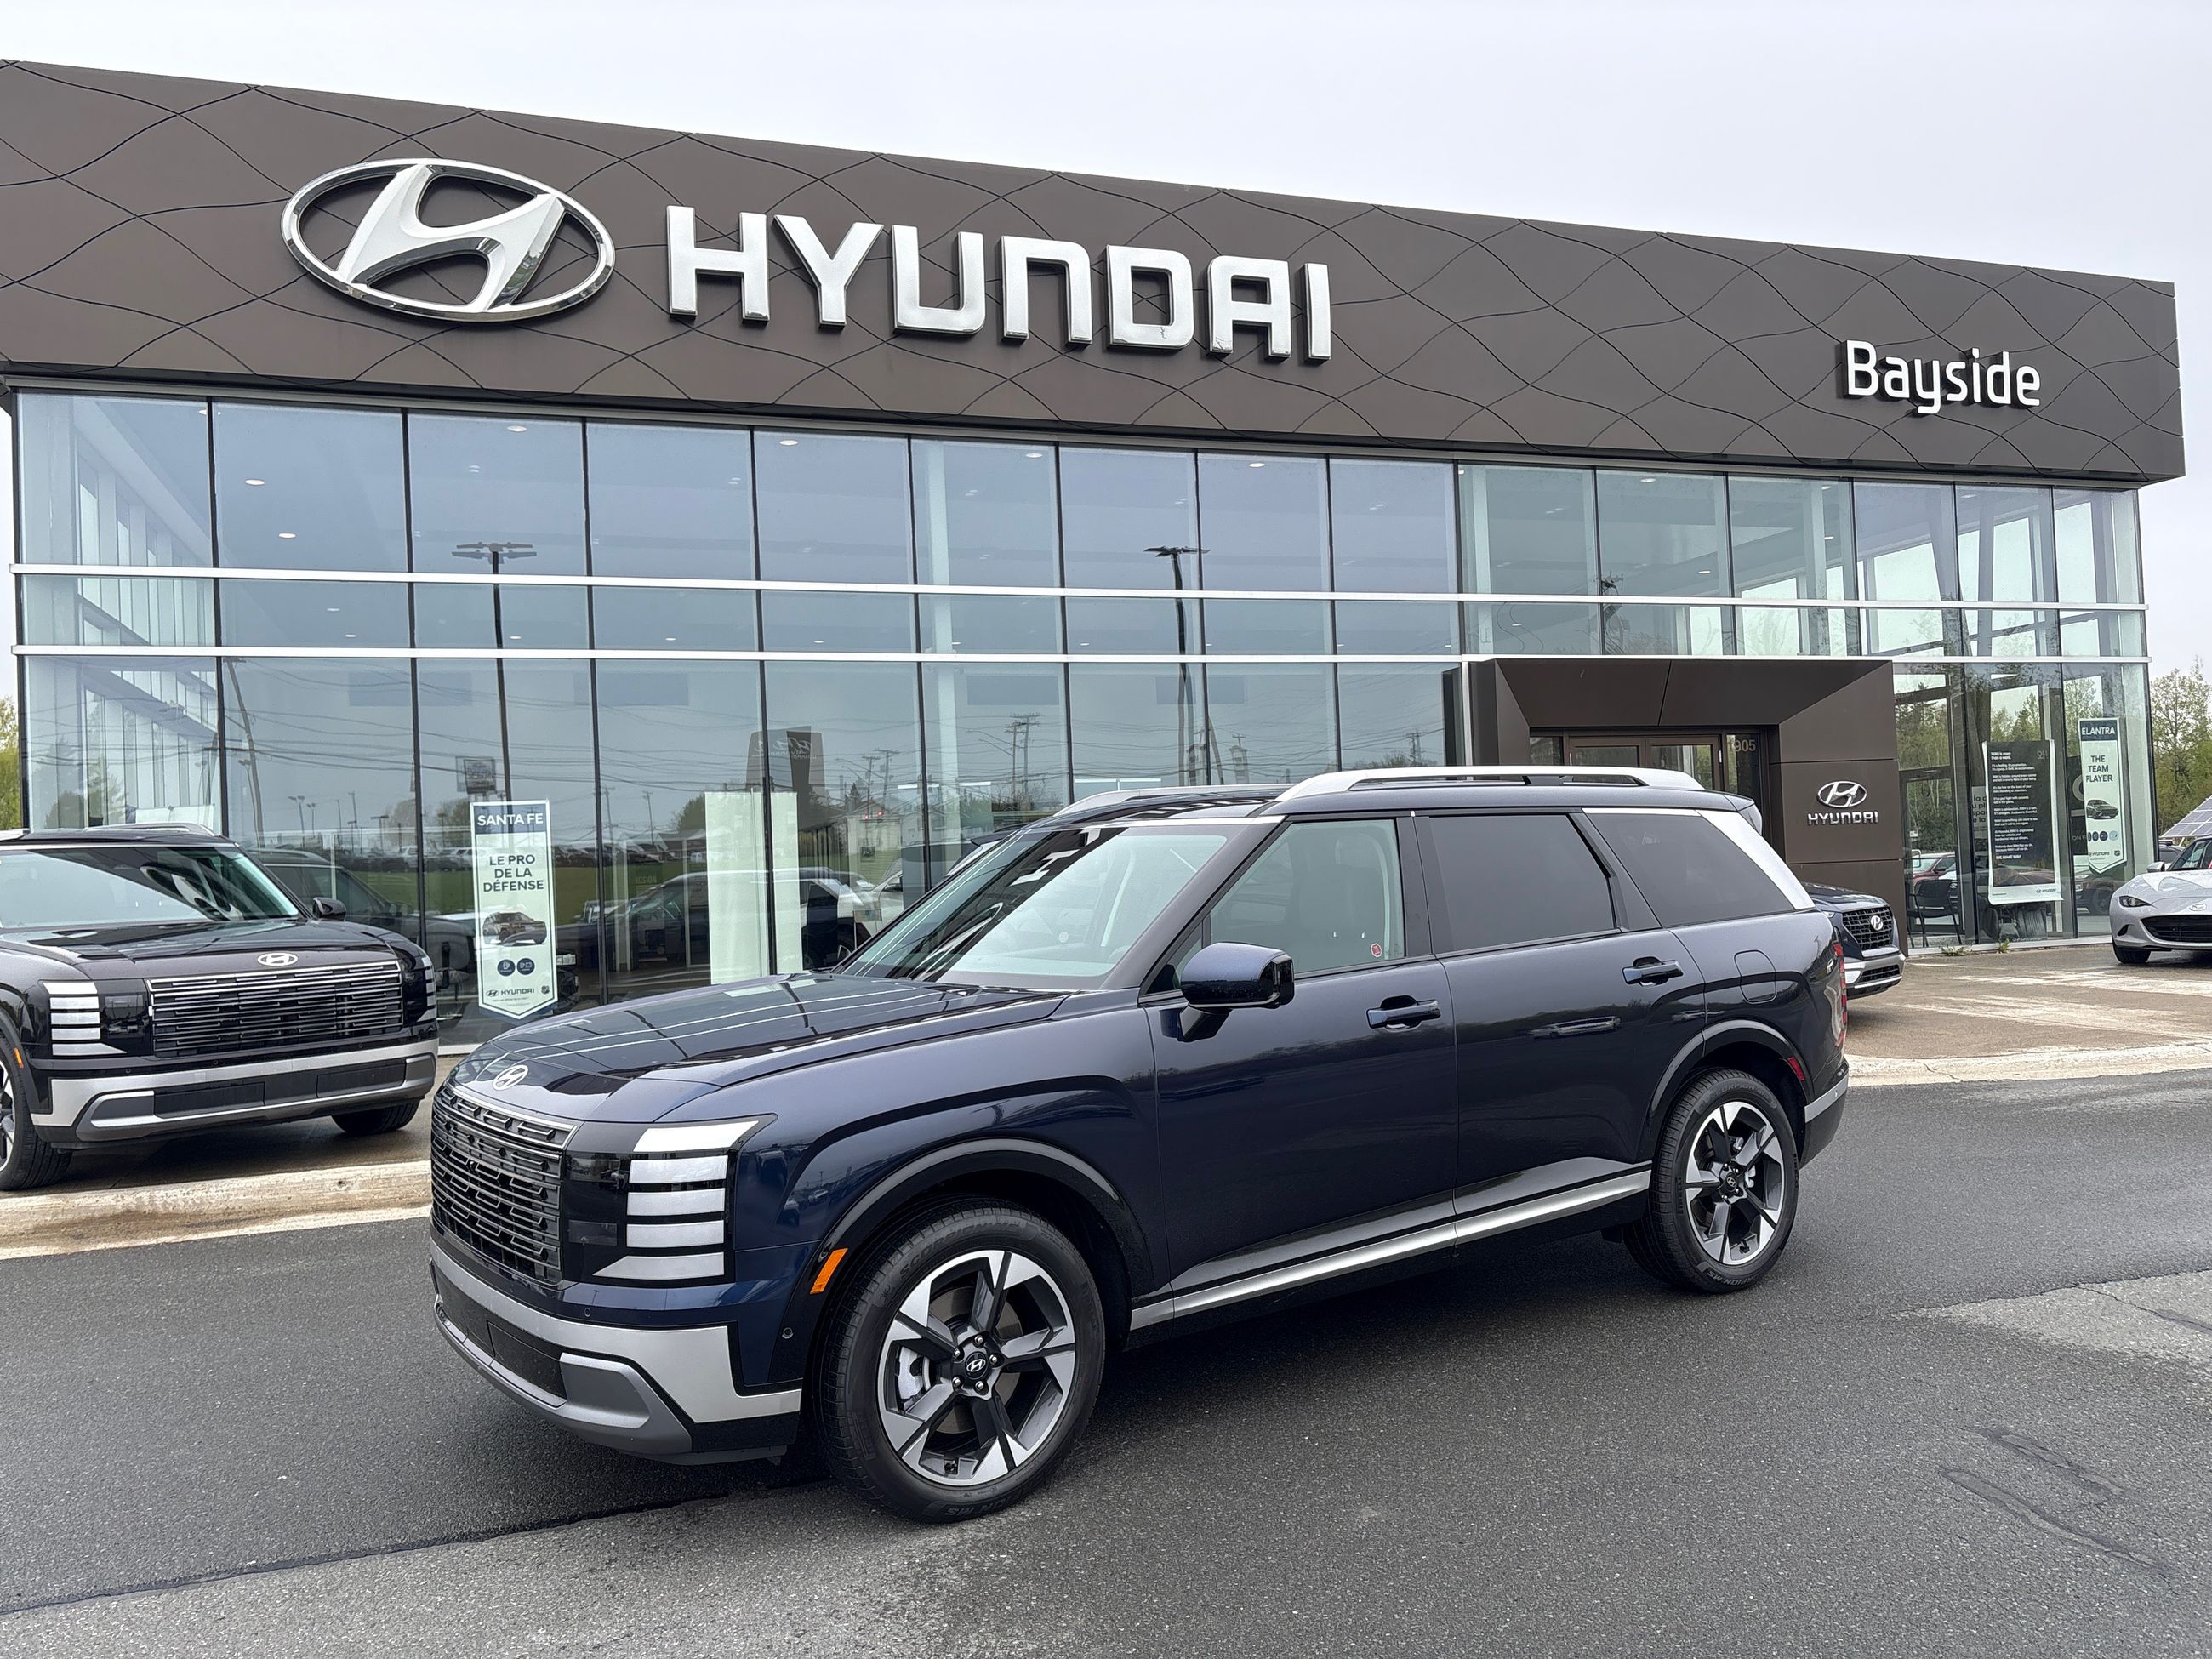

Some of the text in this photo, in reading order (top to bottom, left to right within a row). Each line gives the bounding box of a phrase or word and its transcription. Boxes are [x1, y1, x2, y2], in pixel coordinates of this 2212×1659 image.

[666, 205, 1331, 363] HYUNDAI
[1844, 339, 2041, 415] Bayside
[2081, 727, 2116, 736] ELANTRA
[1734, 739, 1757, 752] 905
[2090, 755, 2106, 763] THE
[2085, 774, 2113, 783] PLAYER
[476, 812, 544, 826] SANTA FE
[1807, 811, 1878, 825] HYUNDAI
[489, 854, 535, 865] LE PRO
[494, 868, 533, 878] DE LA
[482, 880, 544, 892] DÉFENSE
